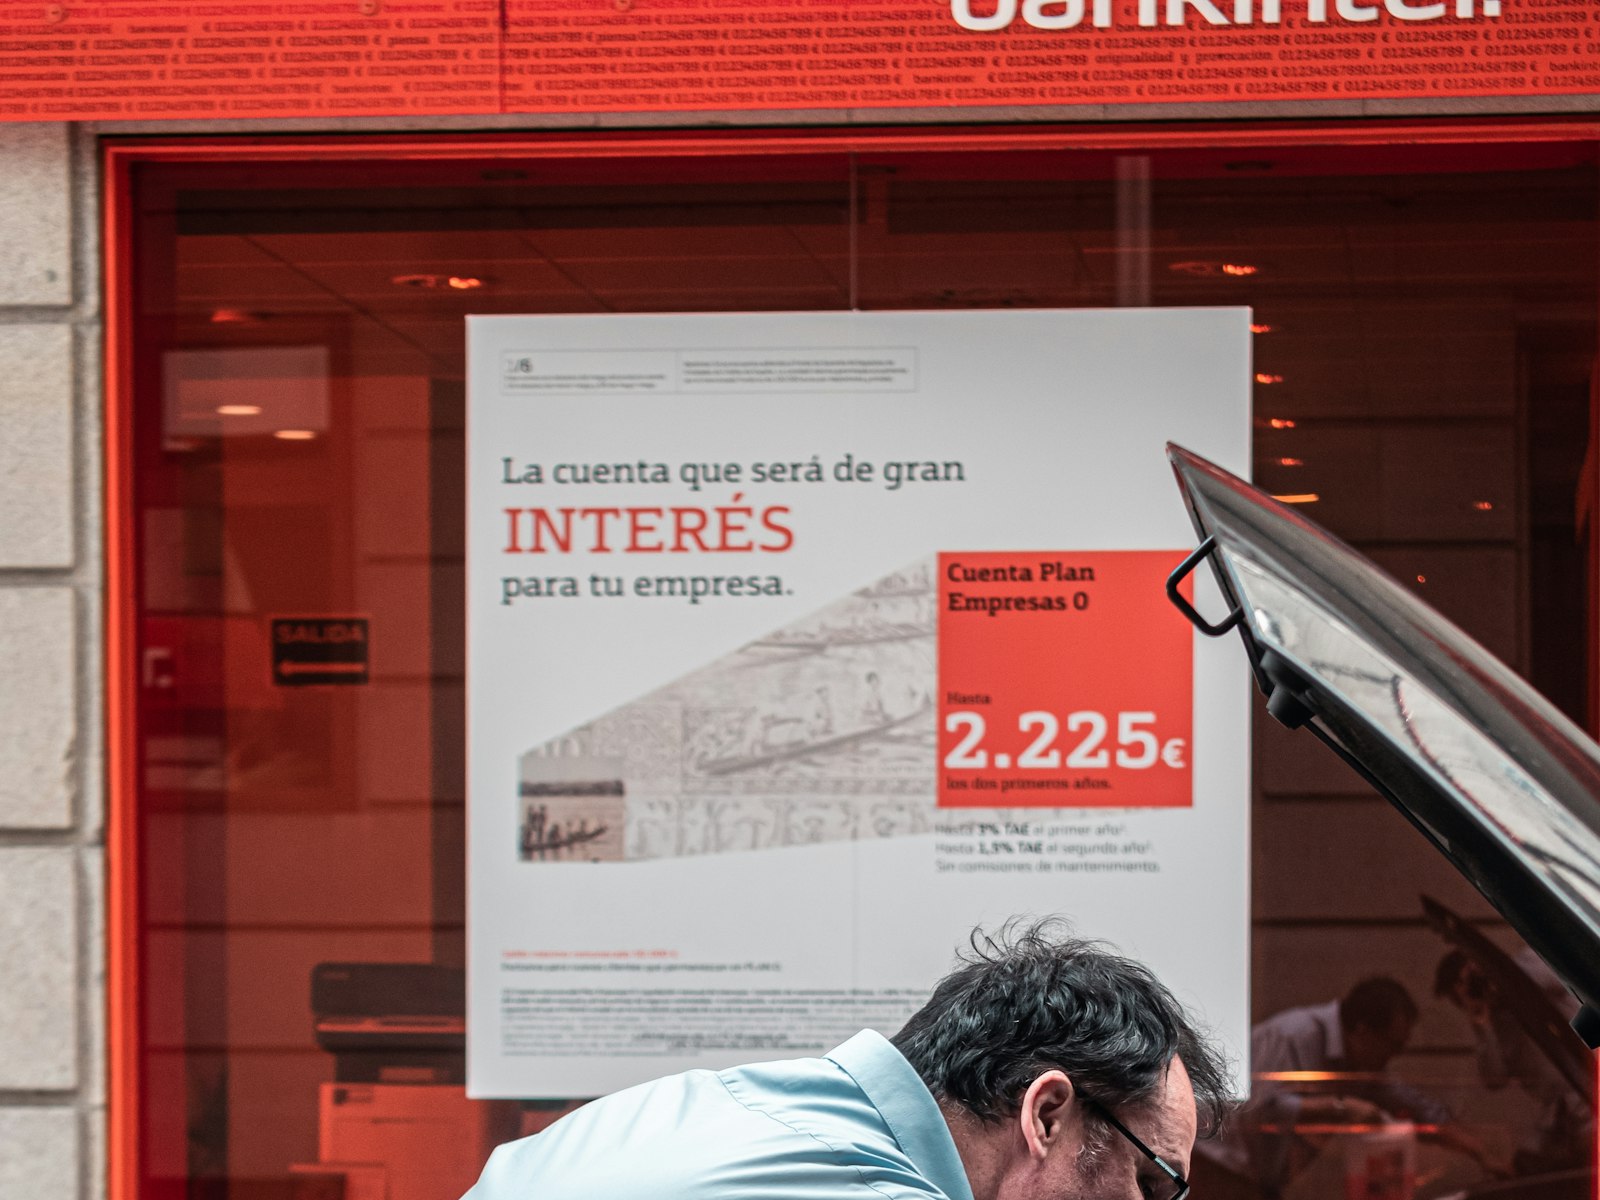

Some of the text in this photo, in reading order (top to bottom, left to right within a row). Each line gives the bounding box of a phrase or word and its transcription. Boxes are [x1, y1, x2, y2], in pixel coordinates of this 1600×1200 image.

[502, 454, 966, 492] La cuenta que será de gran
[504, 493, 795, 553] INTERÉS
[947, 562, 1096, 583] Cuenta Plan
[502, 575, 793, 606] para tu empresa.
[947, 591, 1090, 617] Empresas 0
[947, 693, 993, 705] Hasta
[947, 777, 1112, 793] los dos primeros años.
[1018, 842, 1044, 855] TAE
[1062, 842, 1119, 858] segundo
[936, 861, 1162, 874] Sin comisiones de mantenimiento.
